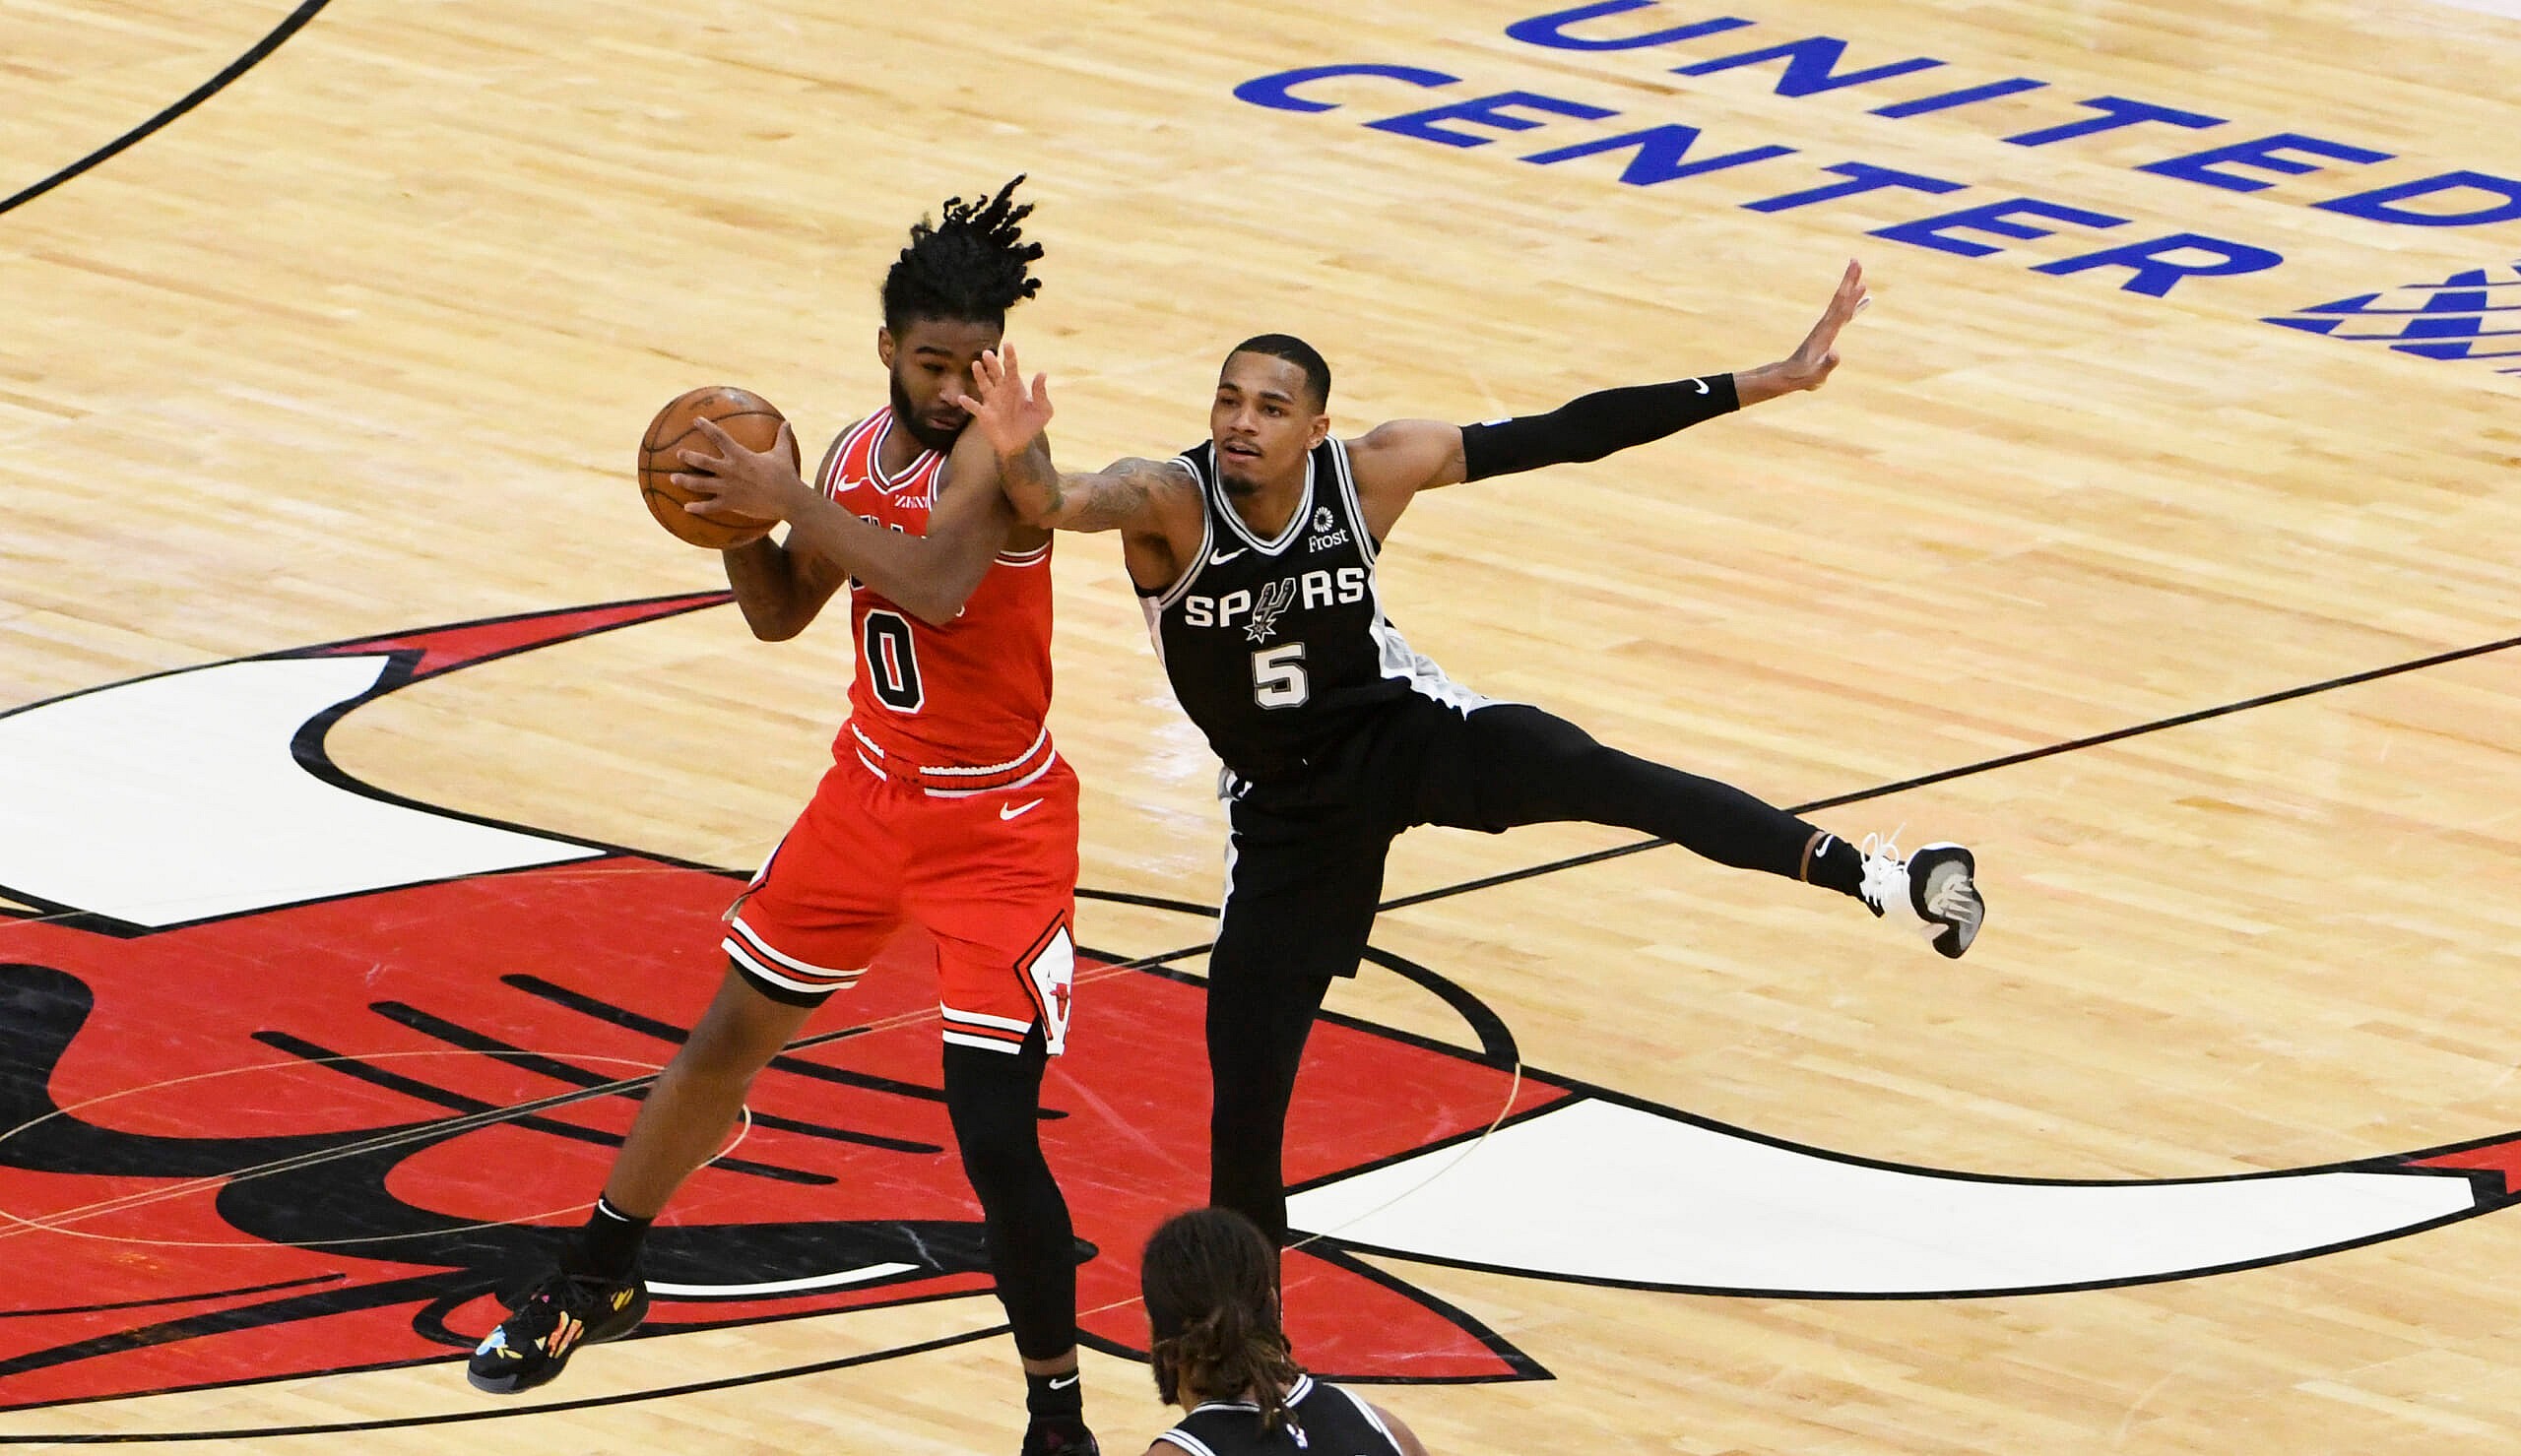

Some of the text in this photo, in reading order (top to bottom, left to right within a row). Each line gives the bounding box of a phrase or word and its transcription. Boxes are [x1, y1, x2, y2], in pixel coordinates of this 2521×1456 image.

[1506, 0, 2521, 227] UNITED
[1234, 64, 2284, 297] CENTER
[894, 494, 929, 509] ZEN
[1308, 528, 1349, 553] Frost
[1185, 567, 1365, 644] SPURS
[864, 608, 925, 714] 0
[1252, 642, 1310, 710] 5
